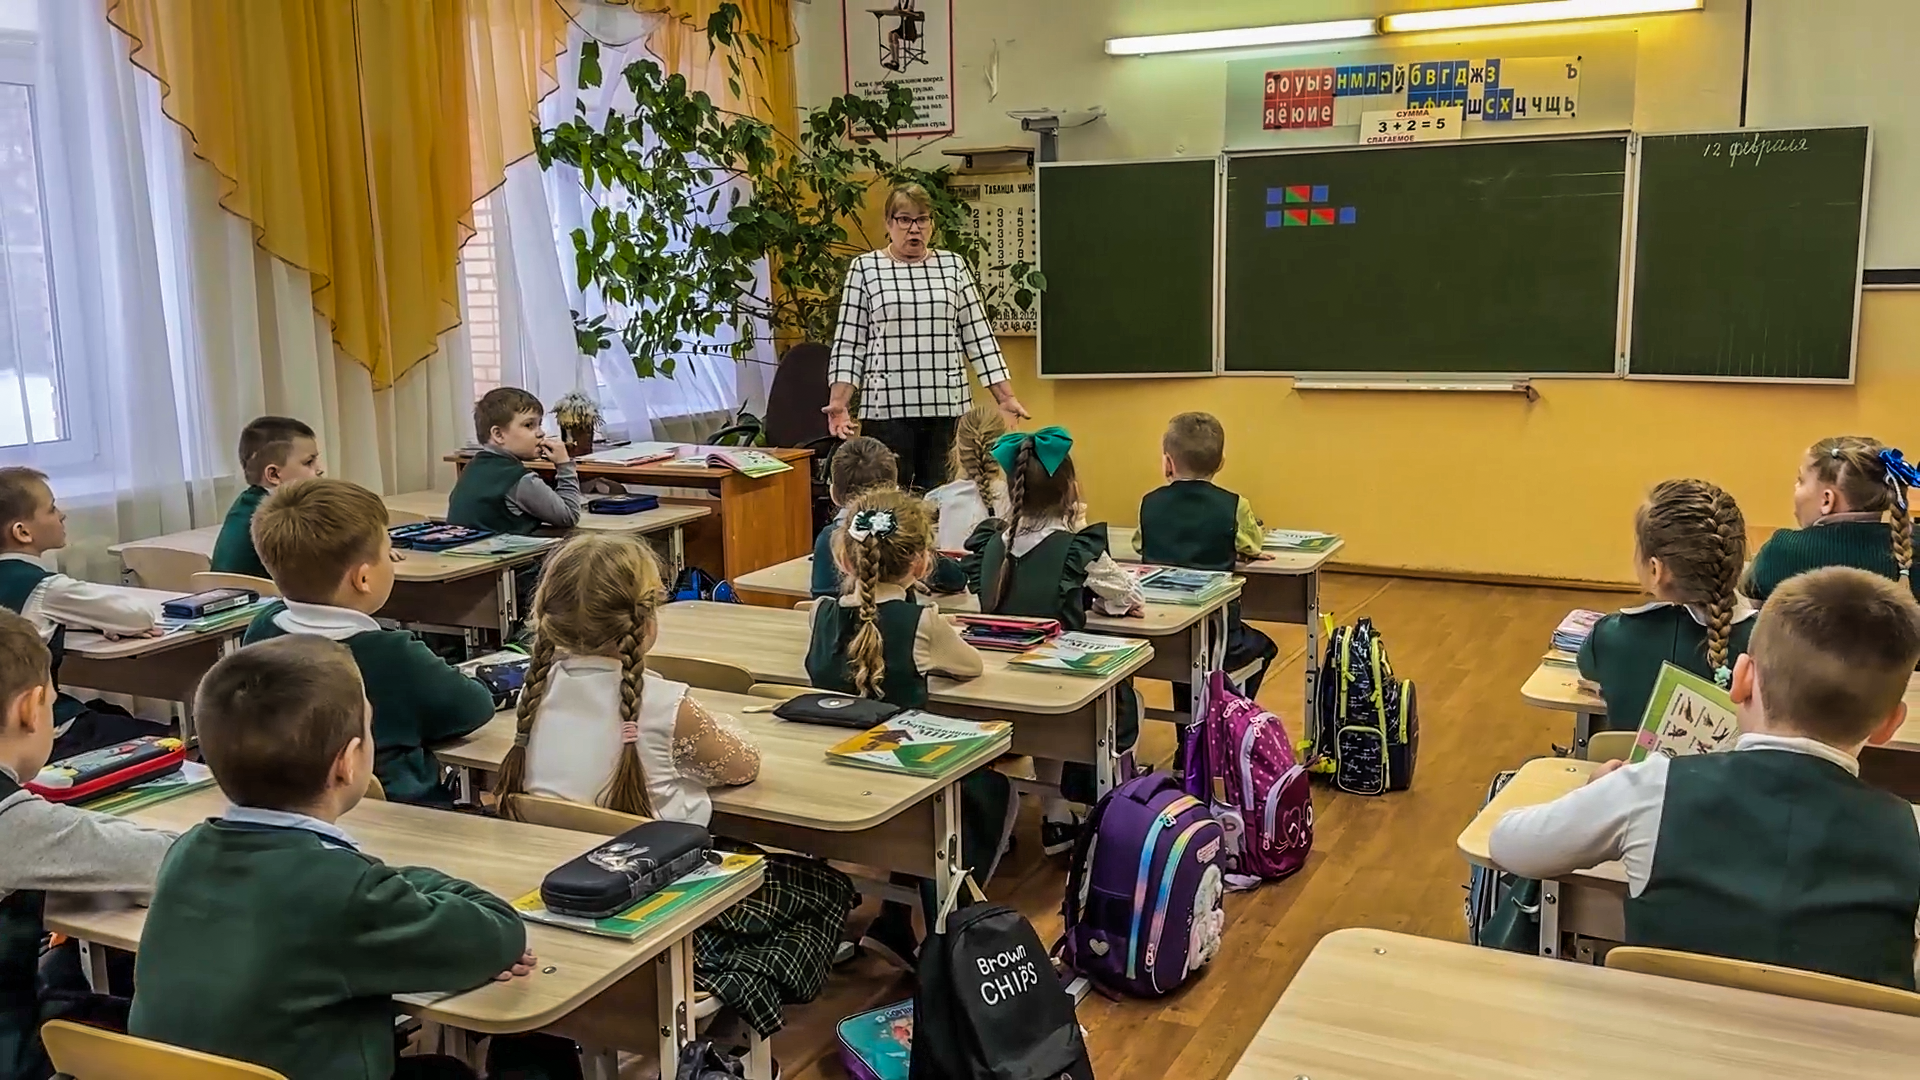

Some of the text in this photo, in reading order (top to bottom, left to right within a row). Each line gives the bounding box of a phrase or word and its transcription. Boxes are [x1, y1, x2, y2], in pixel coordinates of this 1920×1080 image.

[1396, 109, 1429, 118] СУММА
[1378, 122, 1388, 133] 3
[1407, 120, 1416, 131] 2
[1436, 118, 1445, 129] 5
[1366, 135, 1415, 143] СЛАГАЕМОЕ
[1703, 133, 1808, 168] 12 февраля
[976, 944, 1027, 975] Brown
